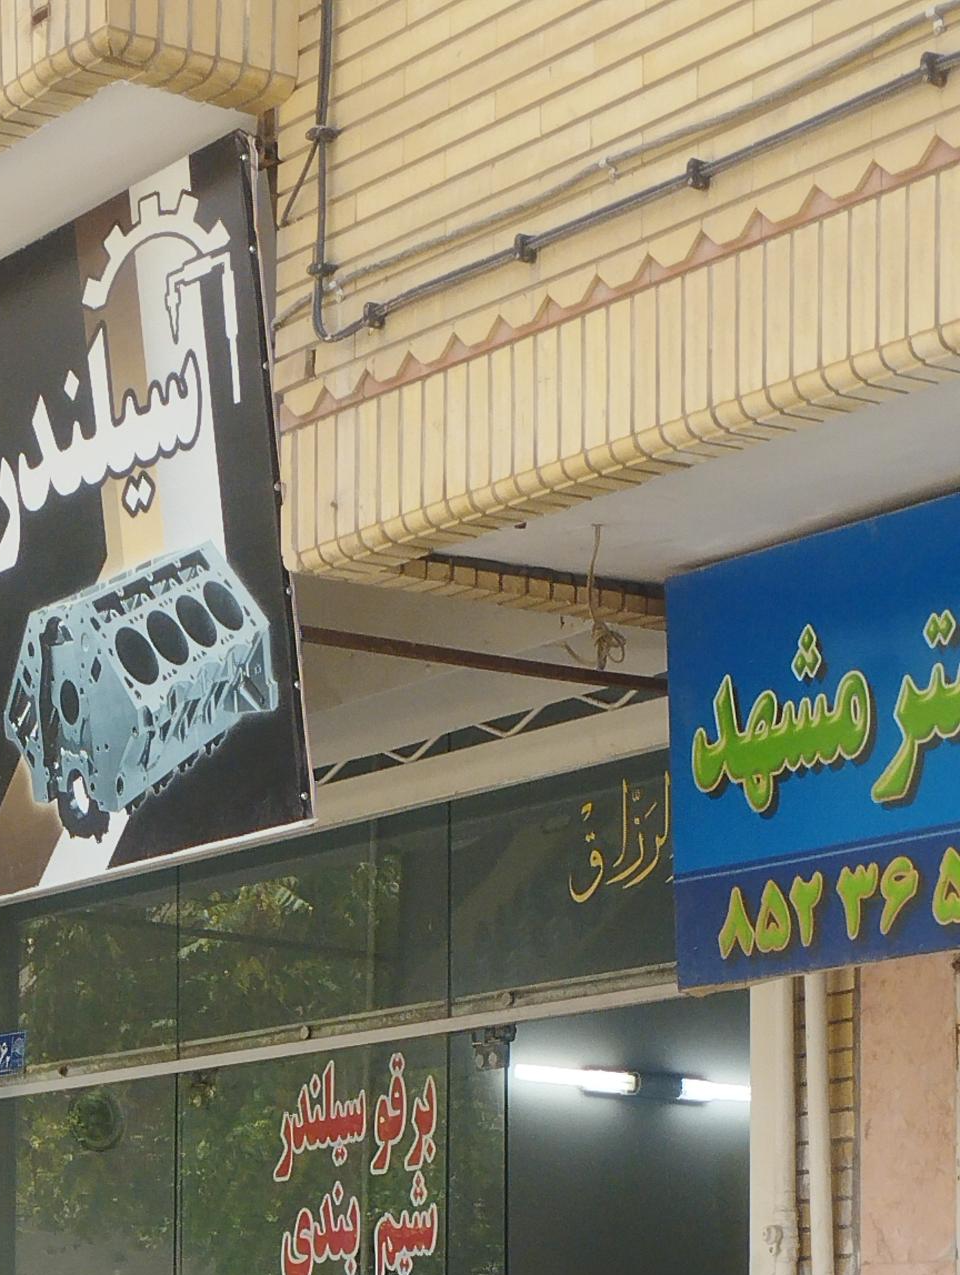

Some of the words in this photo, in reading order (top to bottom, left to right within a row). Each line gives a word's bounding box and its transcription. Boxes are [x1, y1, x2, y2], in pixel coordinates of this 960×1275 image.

[691, 623, 871, 814] مشهد
[871, 608, 960, 803] تر
[718, 870, 823, 961] ۸۵۲
[836, 856, 919, 940] ۳۶
[273, 1060, 367, 1181] سیلندر
[371, 1051, 437, 1175] برقو
